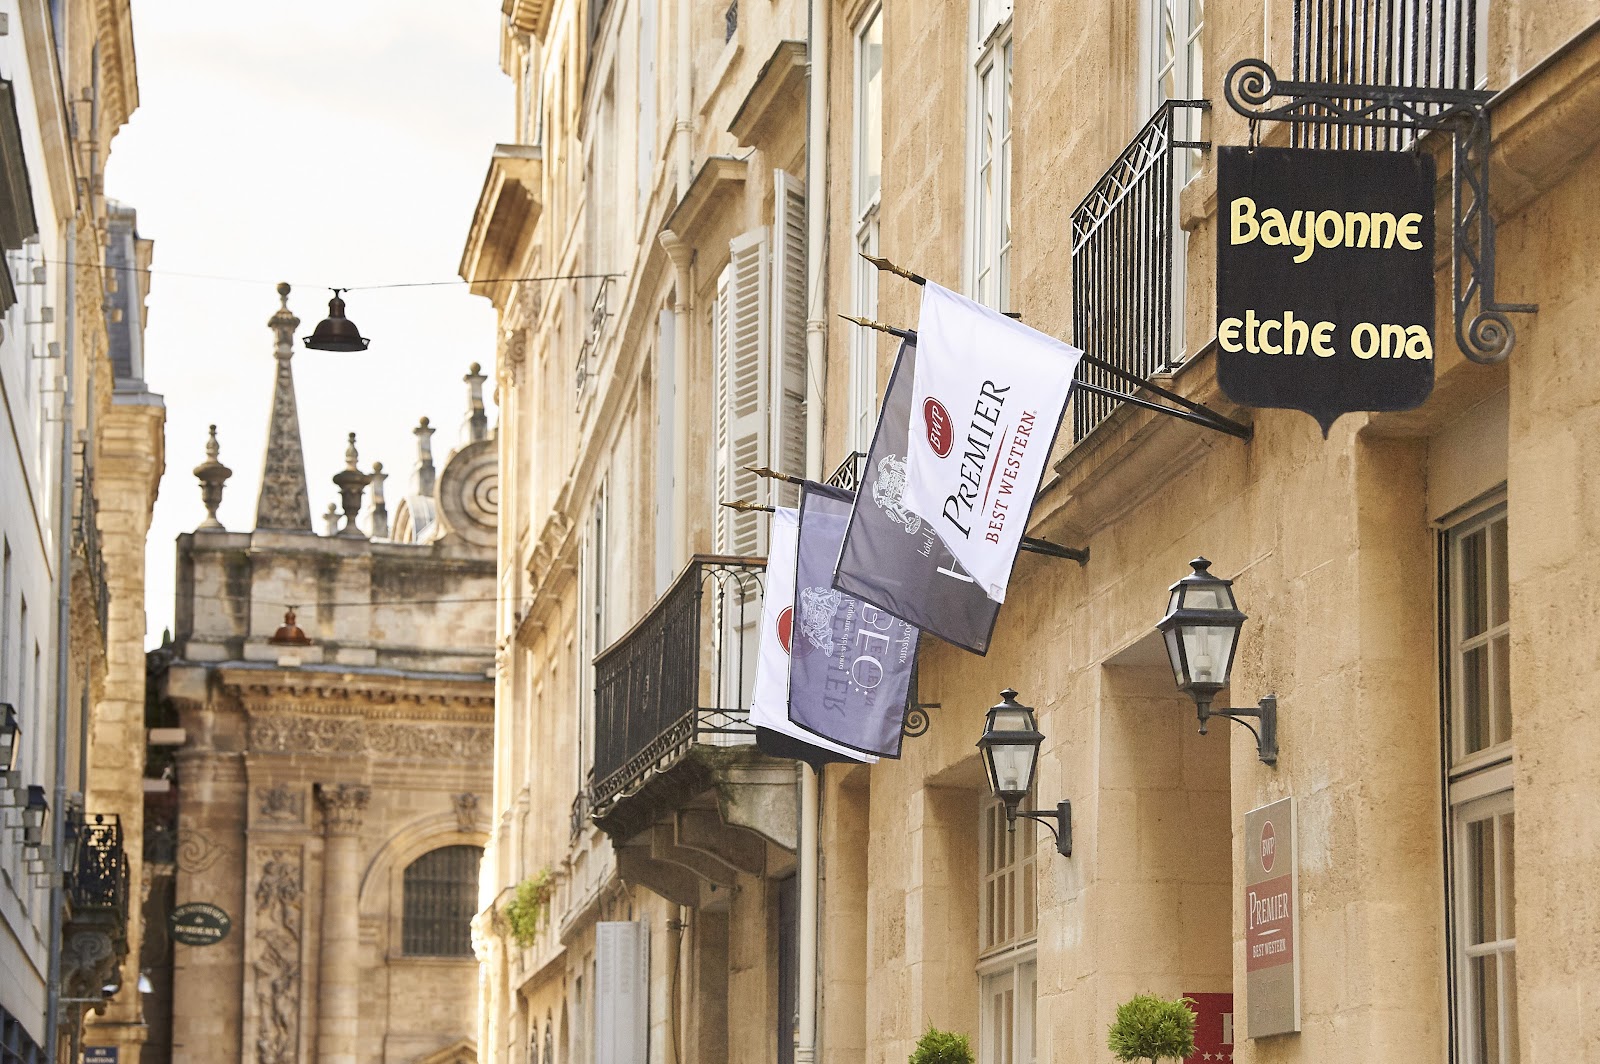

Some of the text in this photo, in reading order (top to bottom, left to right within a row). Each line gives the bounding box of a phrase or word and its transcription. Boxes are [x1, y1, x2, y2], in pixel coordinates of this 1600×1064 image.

[1230, 197, 1423, 263] Bayonne
[1218, 310, 1432, 360] etche ona
[930, 405, 944, 450] BWP
[942, 380, 1010, 540] PREMIER
[985, 410, 1036, 544] BEST WESTERN
[1262, 836, 1275, 857] BWP
[1248, 891, 1289, 930] PREMIER
[1252, 938, 1286, 958] BEST WESTERN
